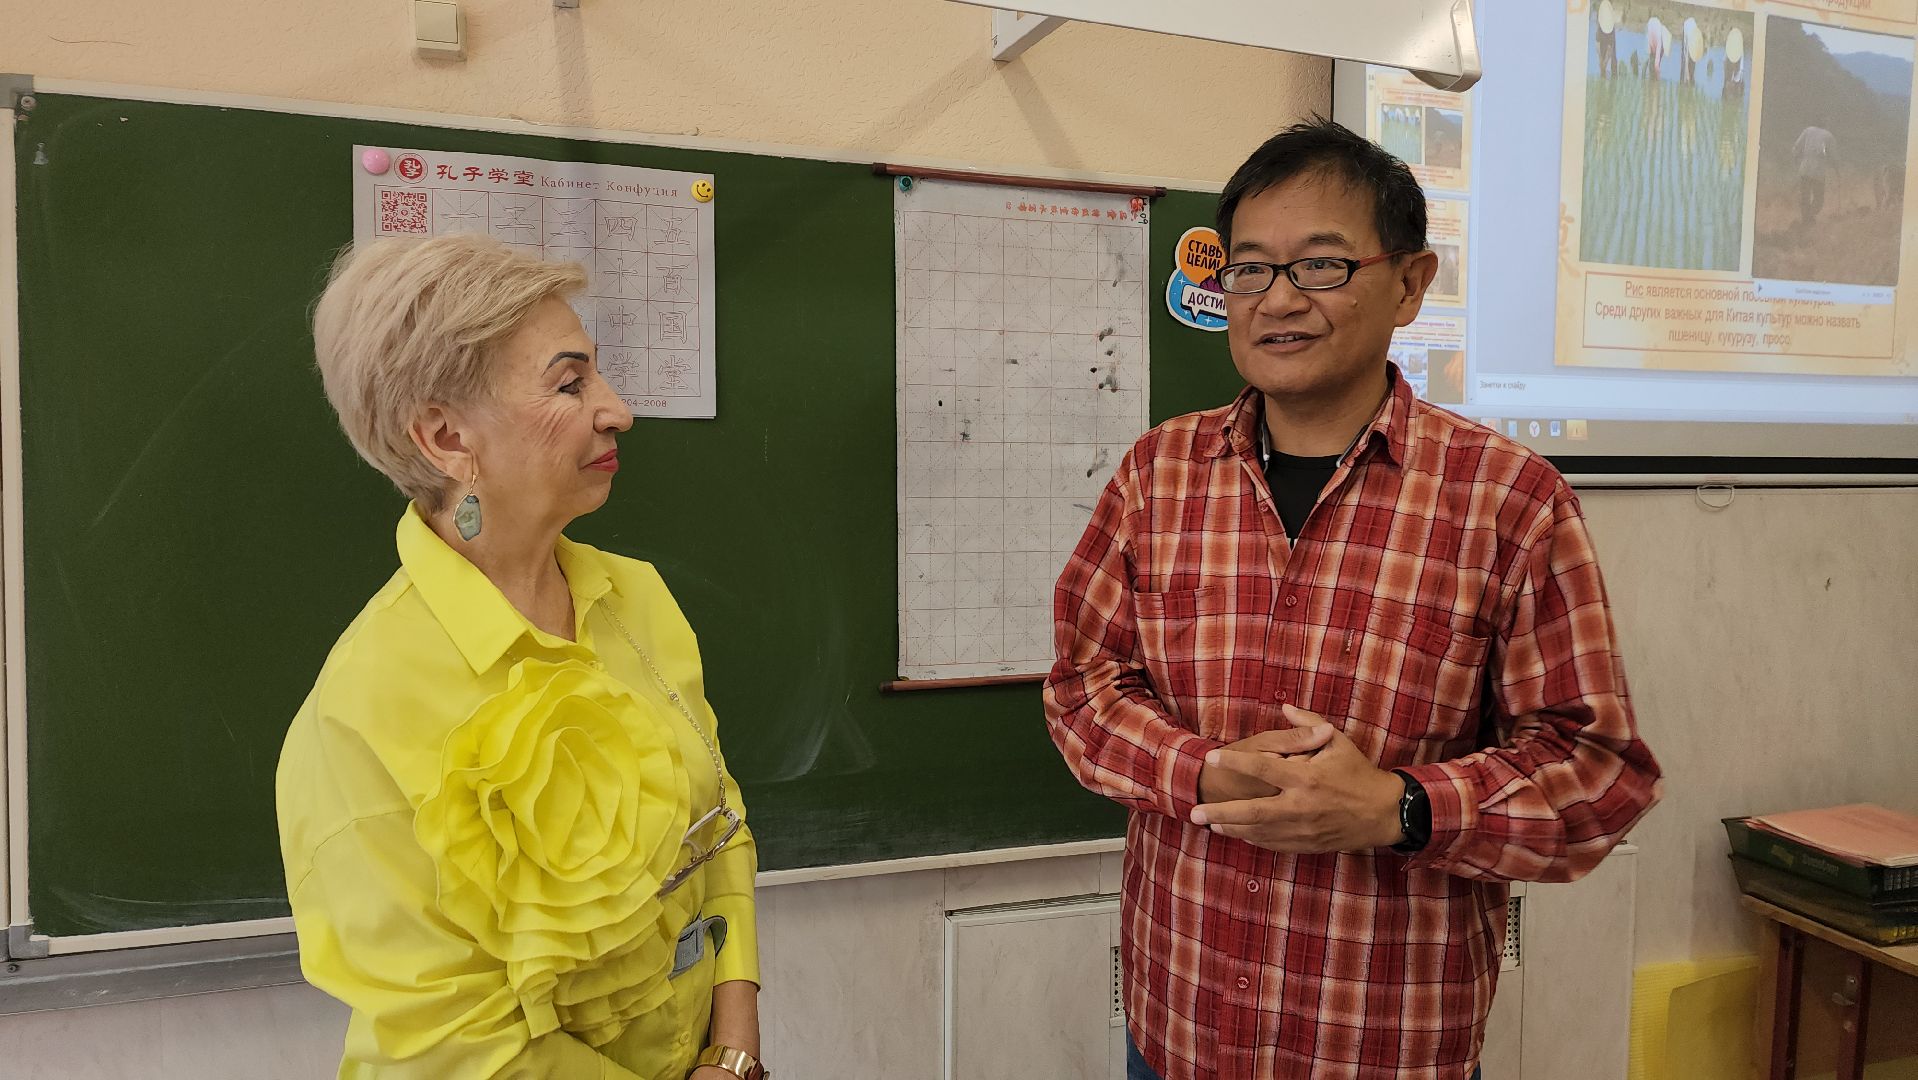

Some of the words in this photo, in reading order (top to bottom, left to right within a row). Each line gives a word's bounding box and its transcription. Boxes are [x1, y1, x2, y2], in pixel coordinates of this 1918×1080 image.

[436, 164, 534, 187] 孔子学堂
[541, 176, 600, 190] Кабинет
[1188, 239, 1223, 259] СТАВЬ
[1625, 280, 1643, 296] Рис
[1646, 285, 1692, 299] является
[1693, 286, 1740, 302] основной
[1595, 301, 1627, 319] Среди
[1629, 305, 1661, 322] других
[1664, 308, 1702, 321] важных
[1704, 309, 1724, 323] для
[1726, 307, 1753, 322] Китая
[1756, 310, 1792, 328] культур
[1794, 313, 1824, 327] можно
[1826, 315, 1861, 329] назвать
